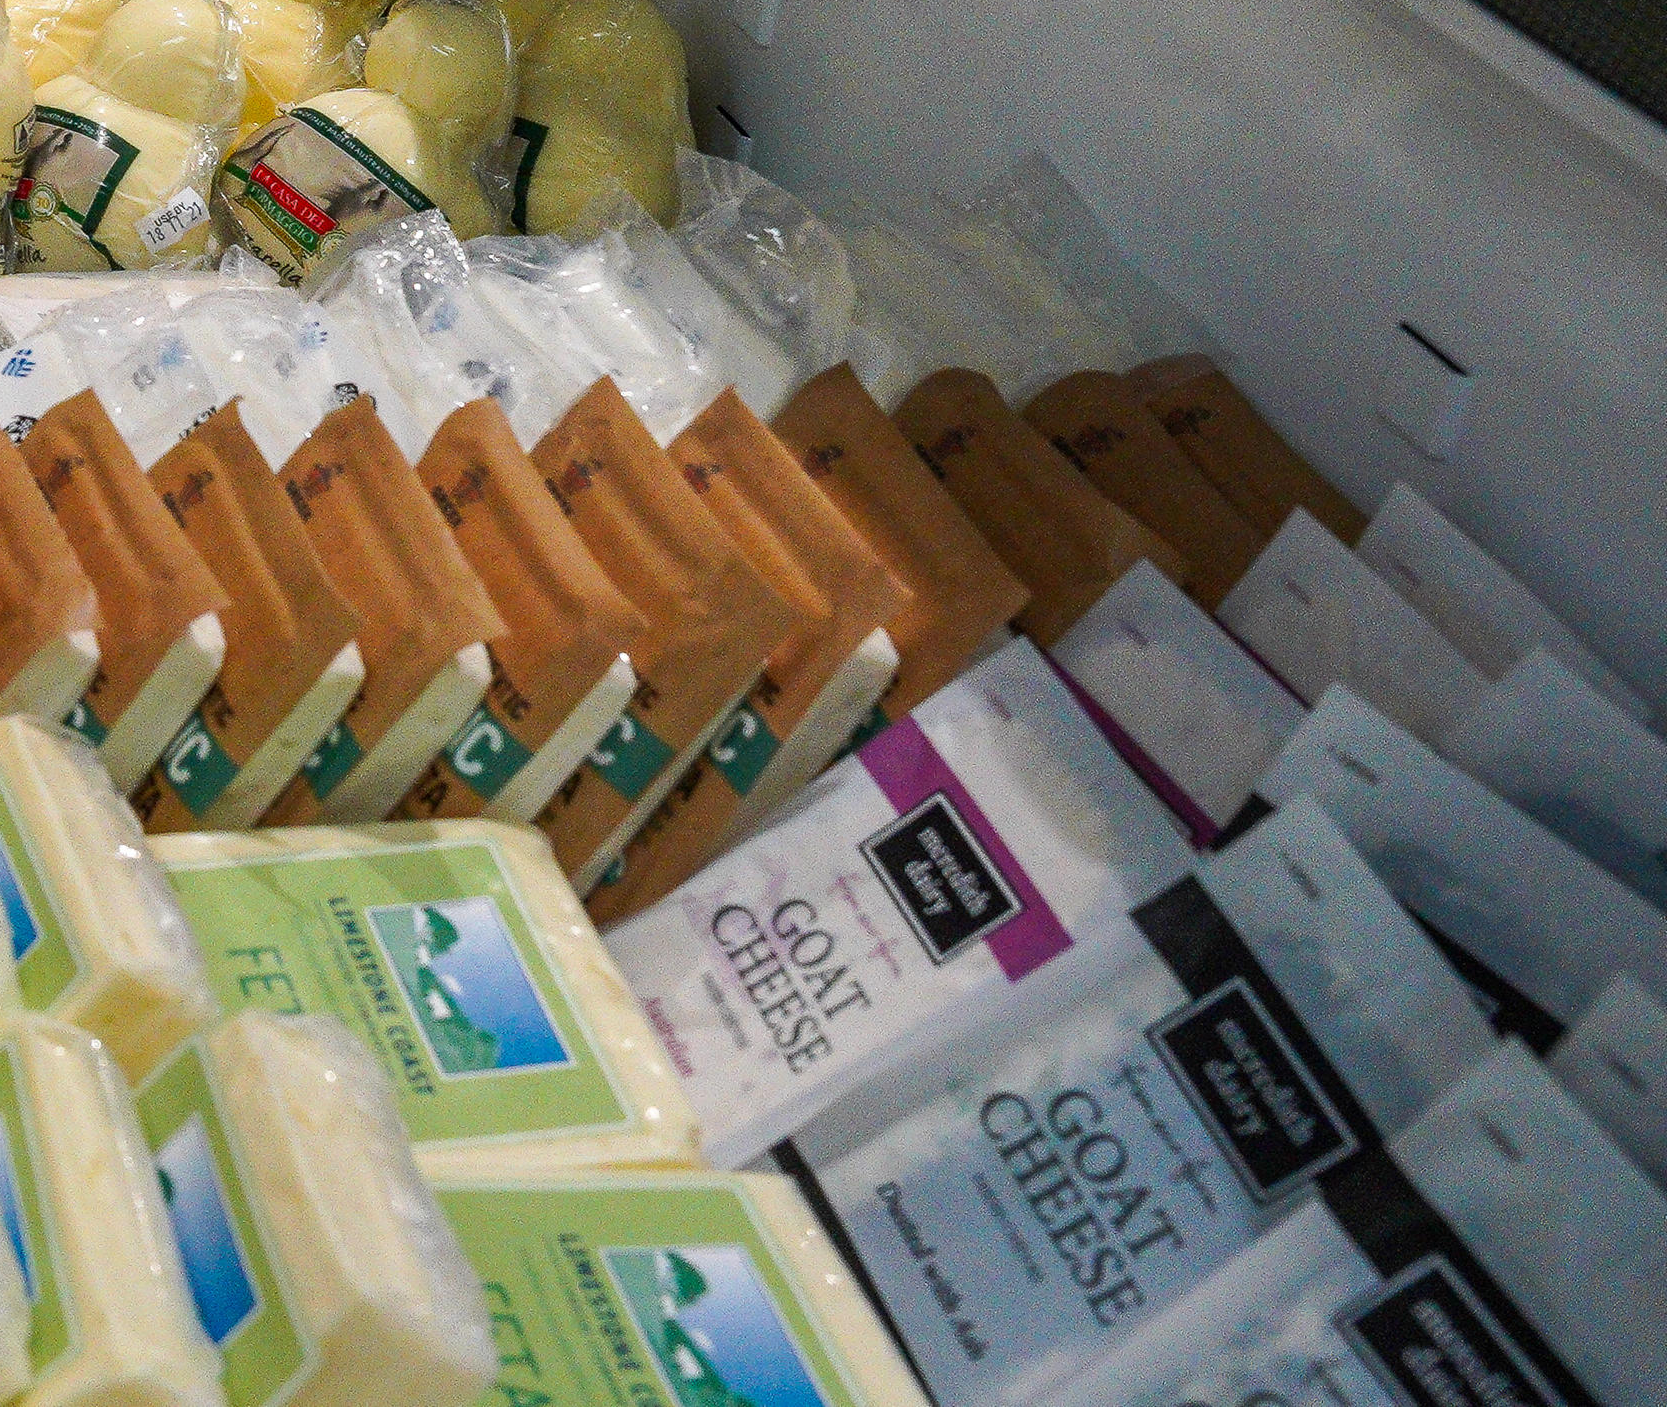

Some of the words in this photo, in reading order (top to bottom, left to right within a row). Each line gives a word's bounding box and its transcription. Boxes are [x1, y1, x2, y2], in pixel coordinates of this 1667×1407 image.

[147, 226, 166, 244] 18
[186, 201, 203, 221] 21
[154, 211, 173, 226] USE
[174, 202, 186, 217] BY
[328, 896, 399, 1026] LIMESTONE
[385, 1026, 436, 1096] COAST
[710, 900, 834, 1074] CHEESE
[770, 897, 870, 1015] GOAT
[1212, 1012, 1317, 1150] meredith
[979, 1088, 1150, 1328] CHEESE
[1041, 1087, 1186, 1259] GOAT
[559, 1234, 638, 1364] LIMESTONE
[877, 1178, 922, 1257] Dusted
[948, 1312, 990, 1365] Ash
